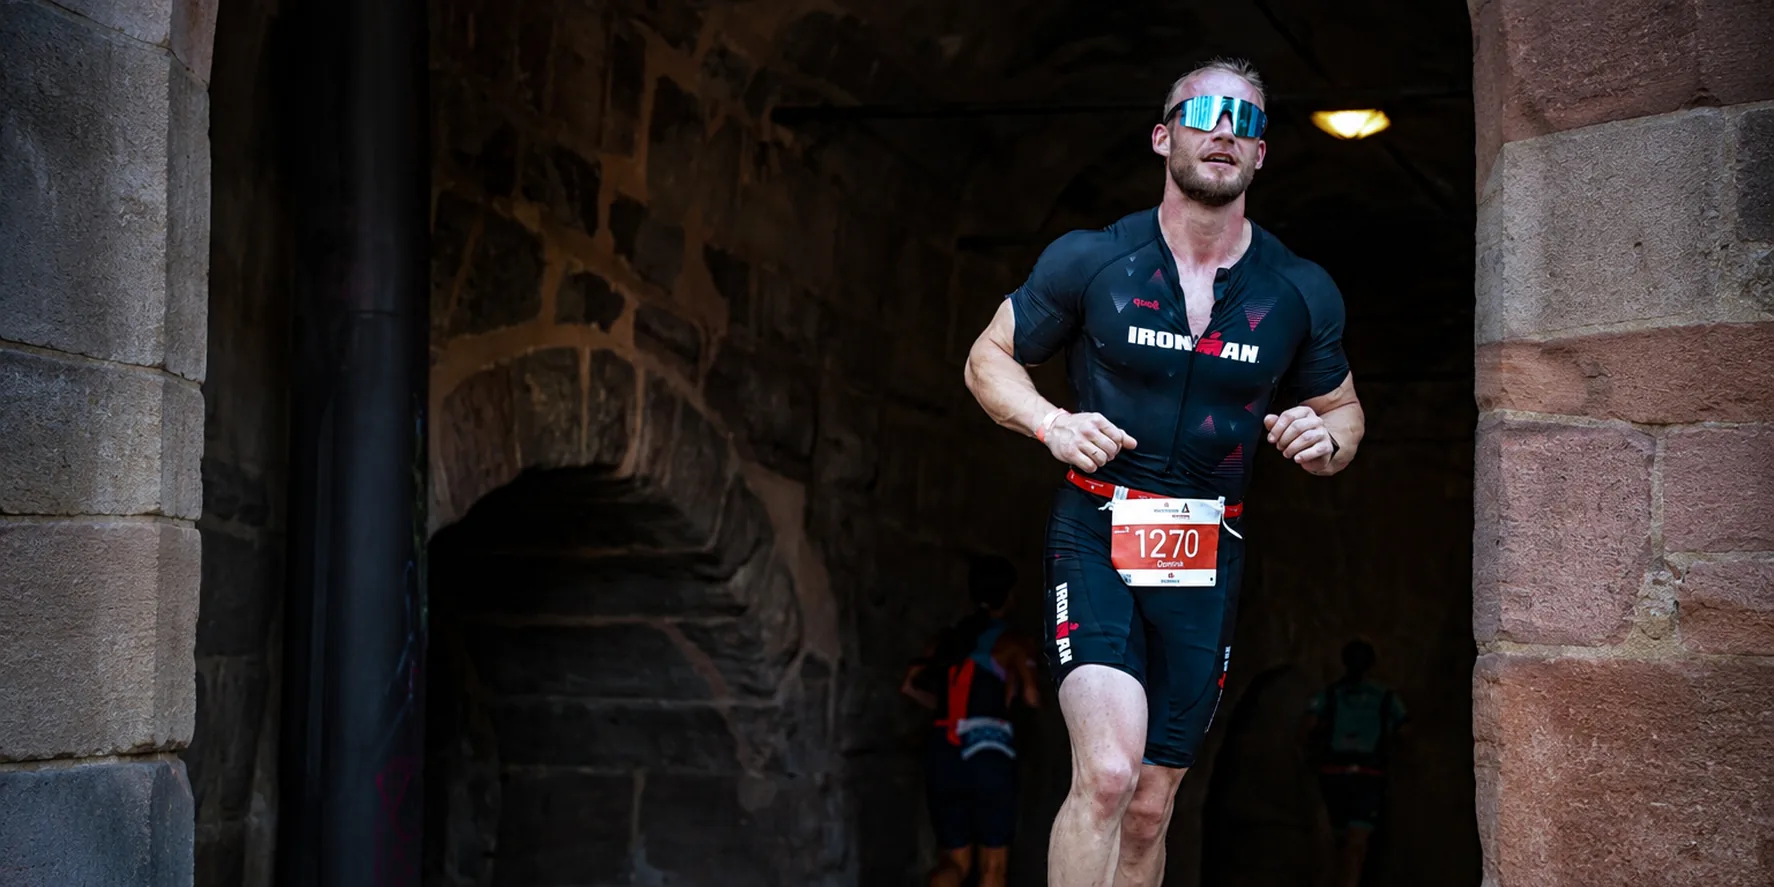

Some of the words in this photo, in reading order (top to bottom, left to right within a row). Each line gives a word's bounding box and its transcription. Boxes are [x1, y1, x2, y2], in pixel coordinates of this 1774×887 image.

[1127, 325, 1260, 364] IRONMAN
[1134, 528, 1199, 559] 1270
[1054, 581, 1080, 666] IRONMAN
